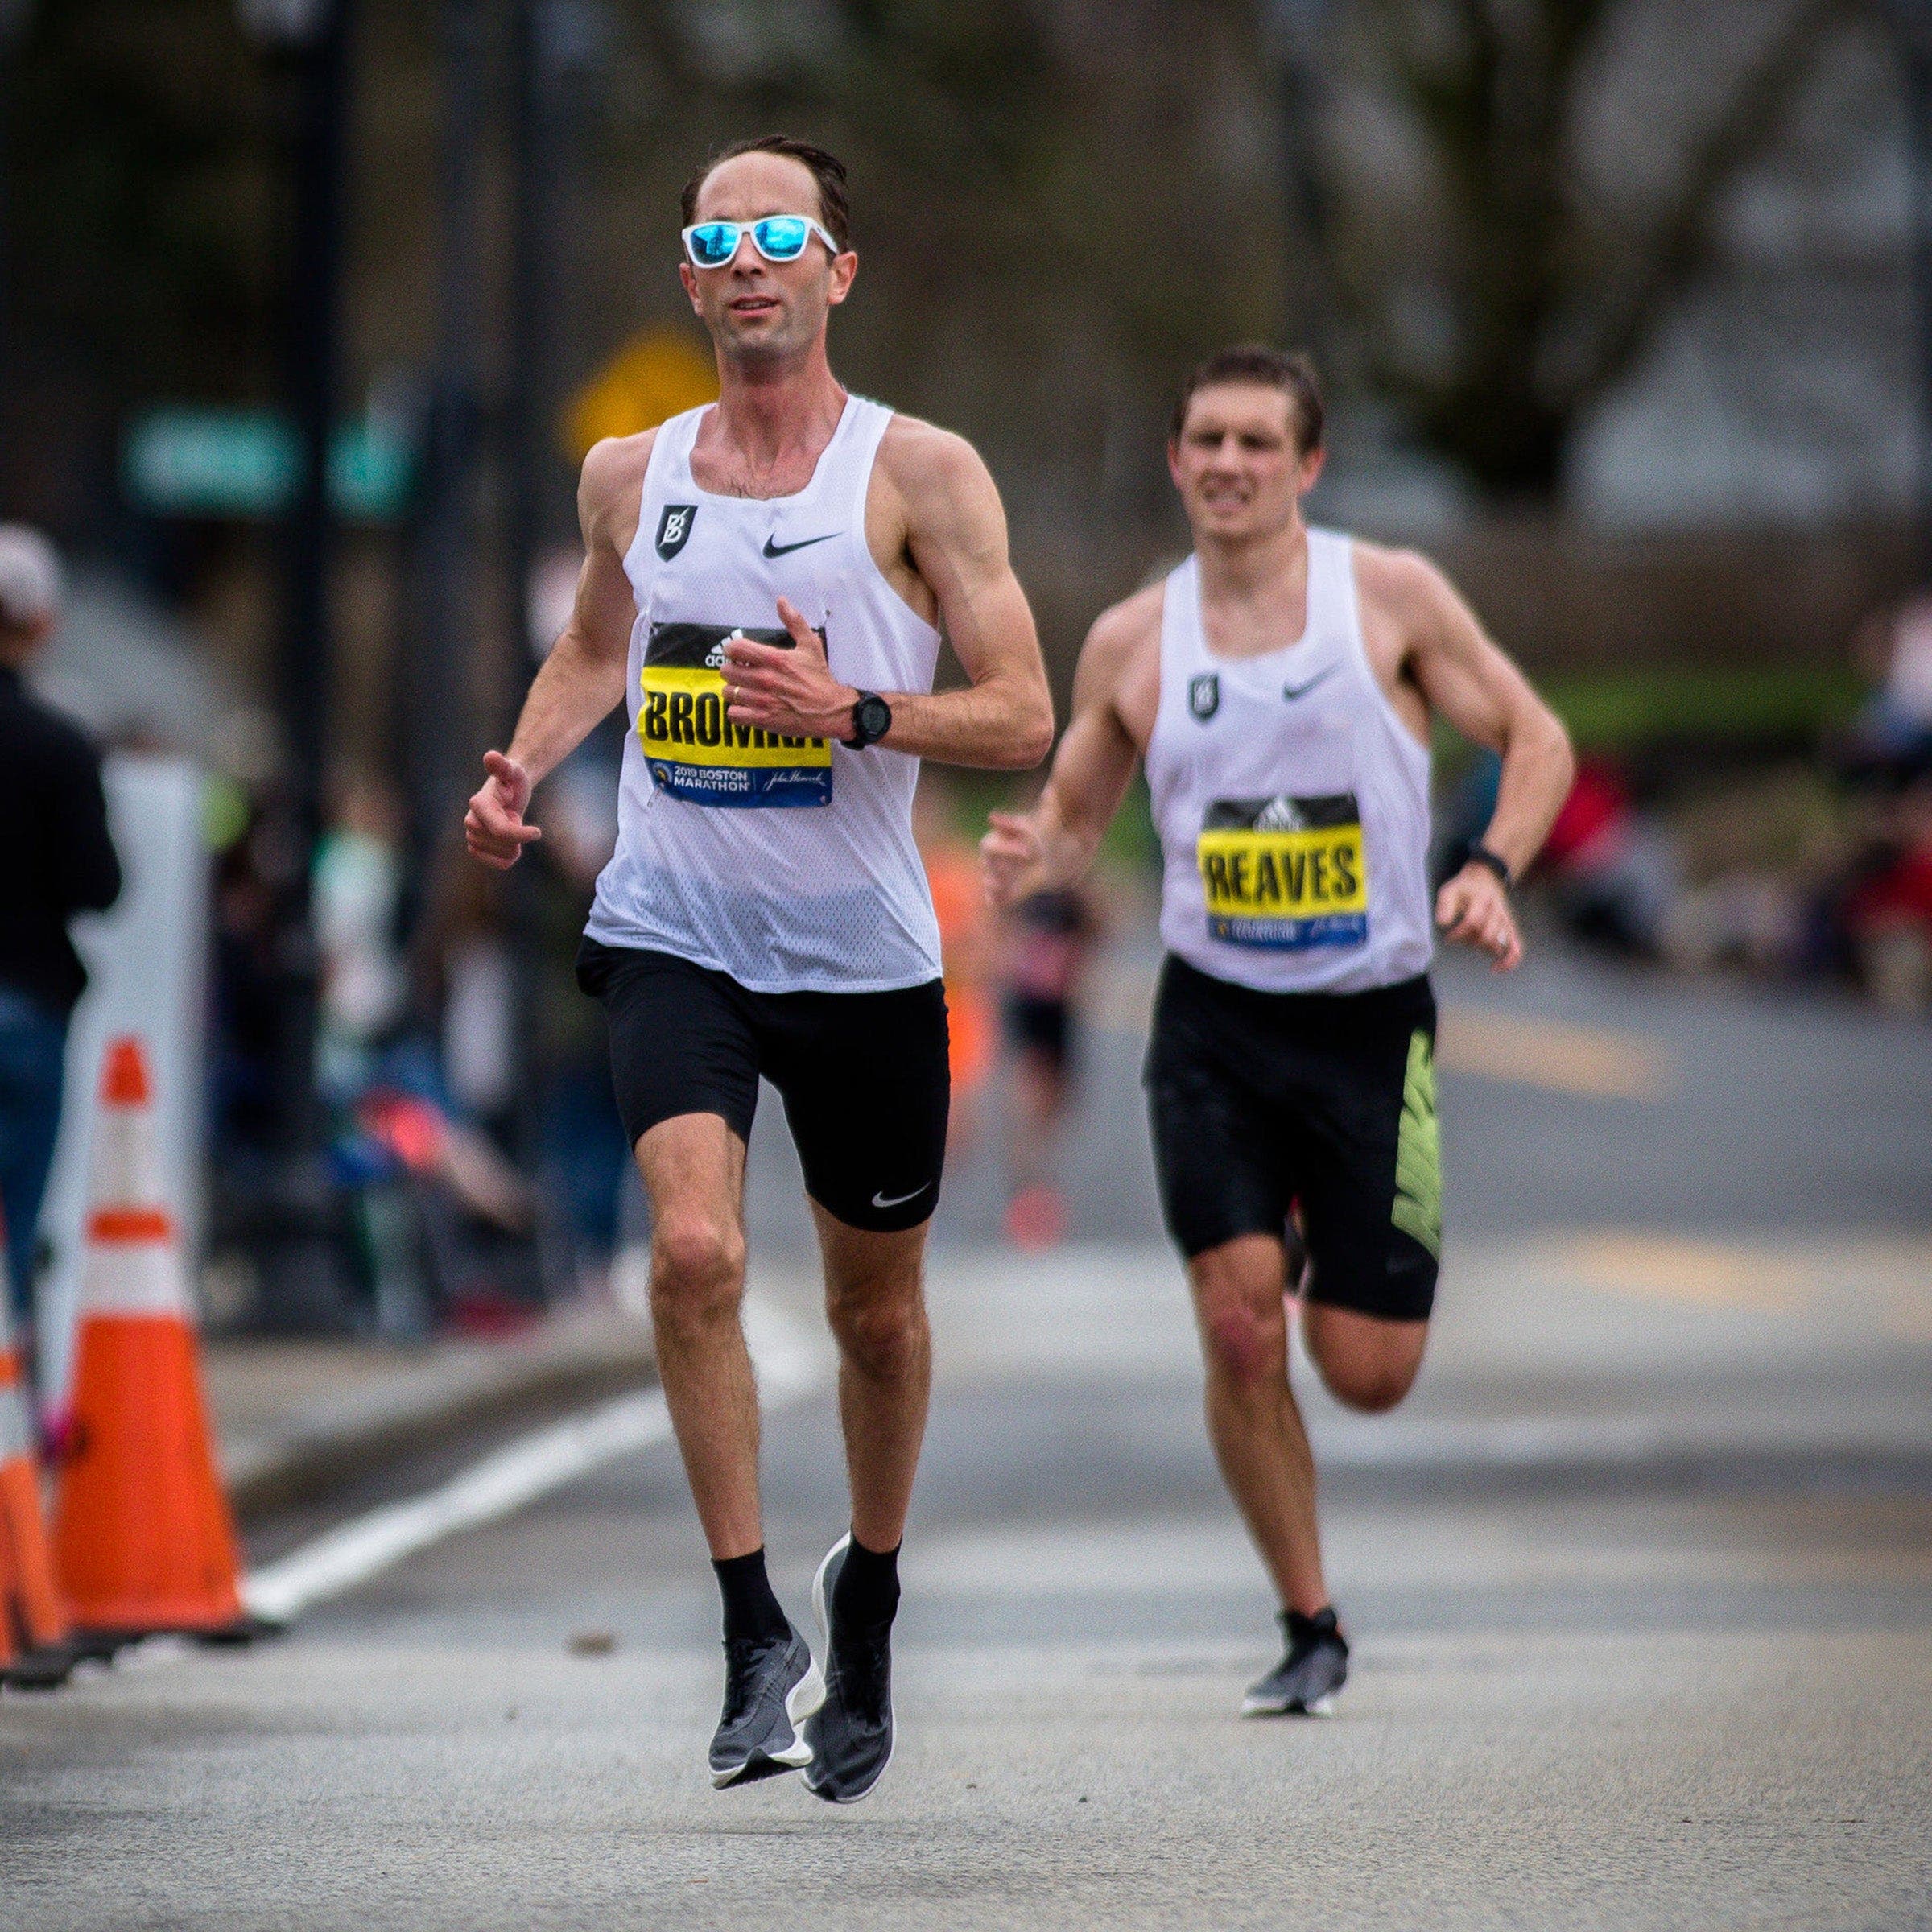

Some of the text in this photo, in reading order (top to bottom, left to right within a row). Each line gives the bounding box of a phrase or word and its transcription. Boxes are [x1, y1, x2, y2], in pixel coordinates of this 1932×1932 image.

[675, 766, 748, 782] 2019 BOSTON
[674, 776, 748, 791] MARATHON
[1206, 845, 1358, 904] REAVES
